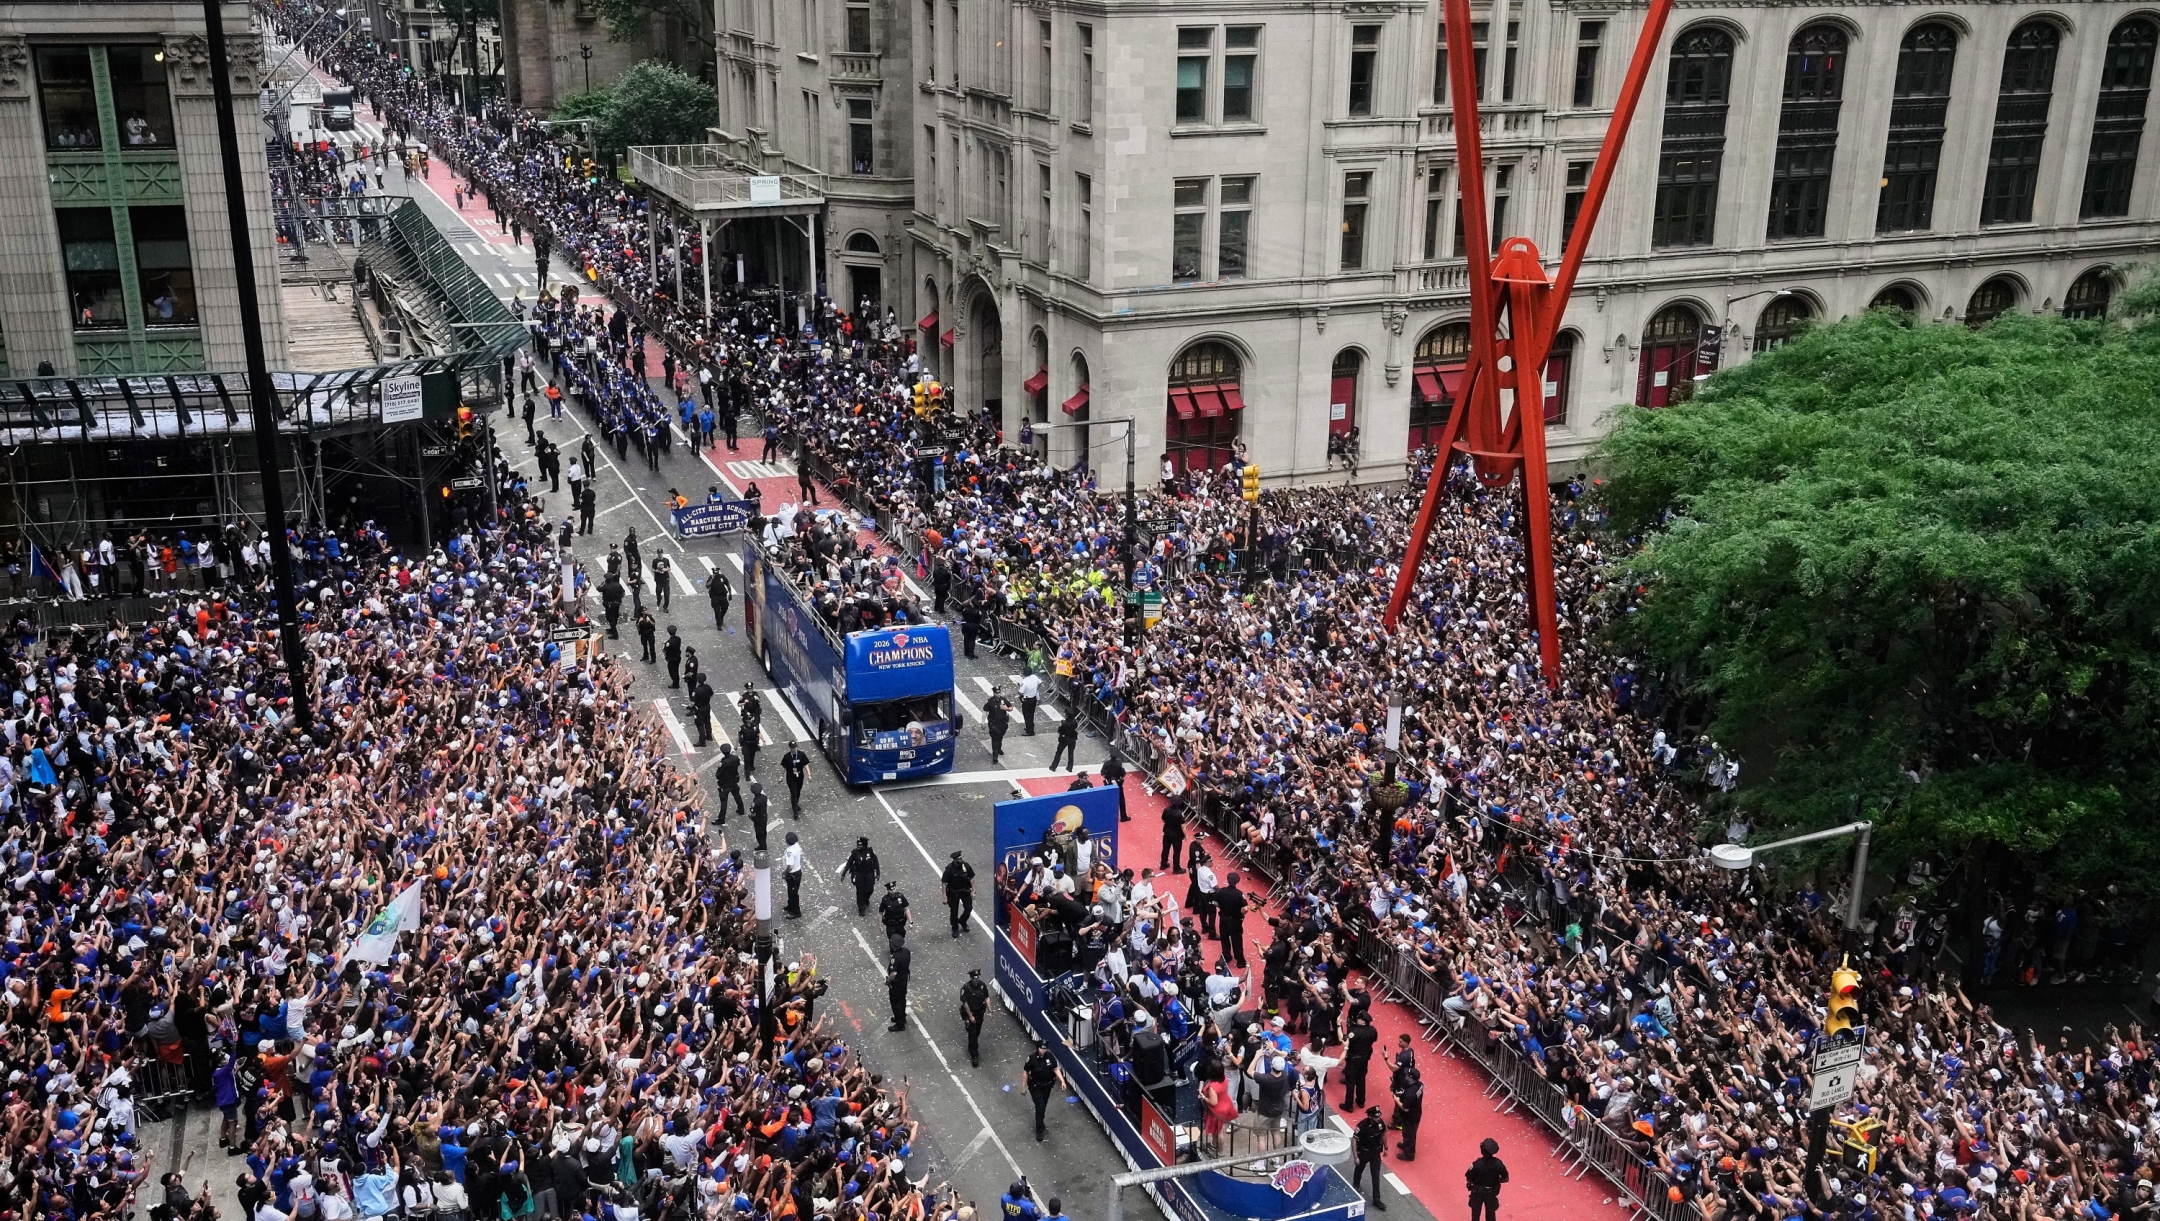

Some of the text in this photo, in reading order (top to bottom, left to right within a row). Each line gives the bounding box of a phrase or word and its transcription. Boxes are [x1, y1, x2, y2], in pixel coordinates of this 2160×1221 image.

[752, 178, 779, 186] SPRING
[388, 380, 420, 394] Skyline
[423, 447, 440, 455] Cedar
[725, 457, 799, 480] ONLY
[680, 506, 706, 525] ALL-CITY
[708, 504, 723, 512] HIGH
[690, 513, 739, 526] MARCHING BAND
[684, 526, 698, 534] NEW
[701, 523, 717, 532] YORK
[1151, 522, 1169, 532] Cedar
[873, 636, 929, 648] 2026 NBA
[868, 645, 934, 666] CHAMPIONS
[906, 660, 926, 668] KNICKS
[1000, 954, 1026, 996] CHASE
[1165, 965, 1172, 976] 4
[1820, 1040, 1841, 1051] BUSES
[1840, 1045, 1860, 1056] 4PM-7PM
[1833, 1053, 1852, 1063] MON-FRI
[1821, 1085, 1845, 1098] BUS LANES
[1813, 1090, 1850, 1106] PHOTO ENFORCED
[1274, 1162, 1312, 1187] KNICKS
[1005, 1202, 1022, 1214] NYPD
[1351, 1209, 1357, 1217] 3
